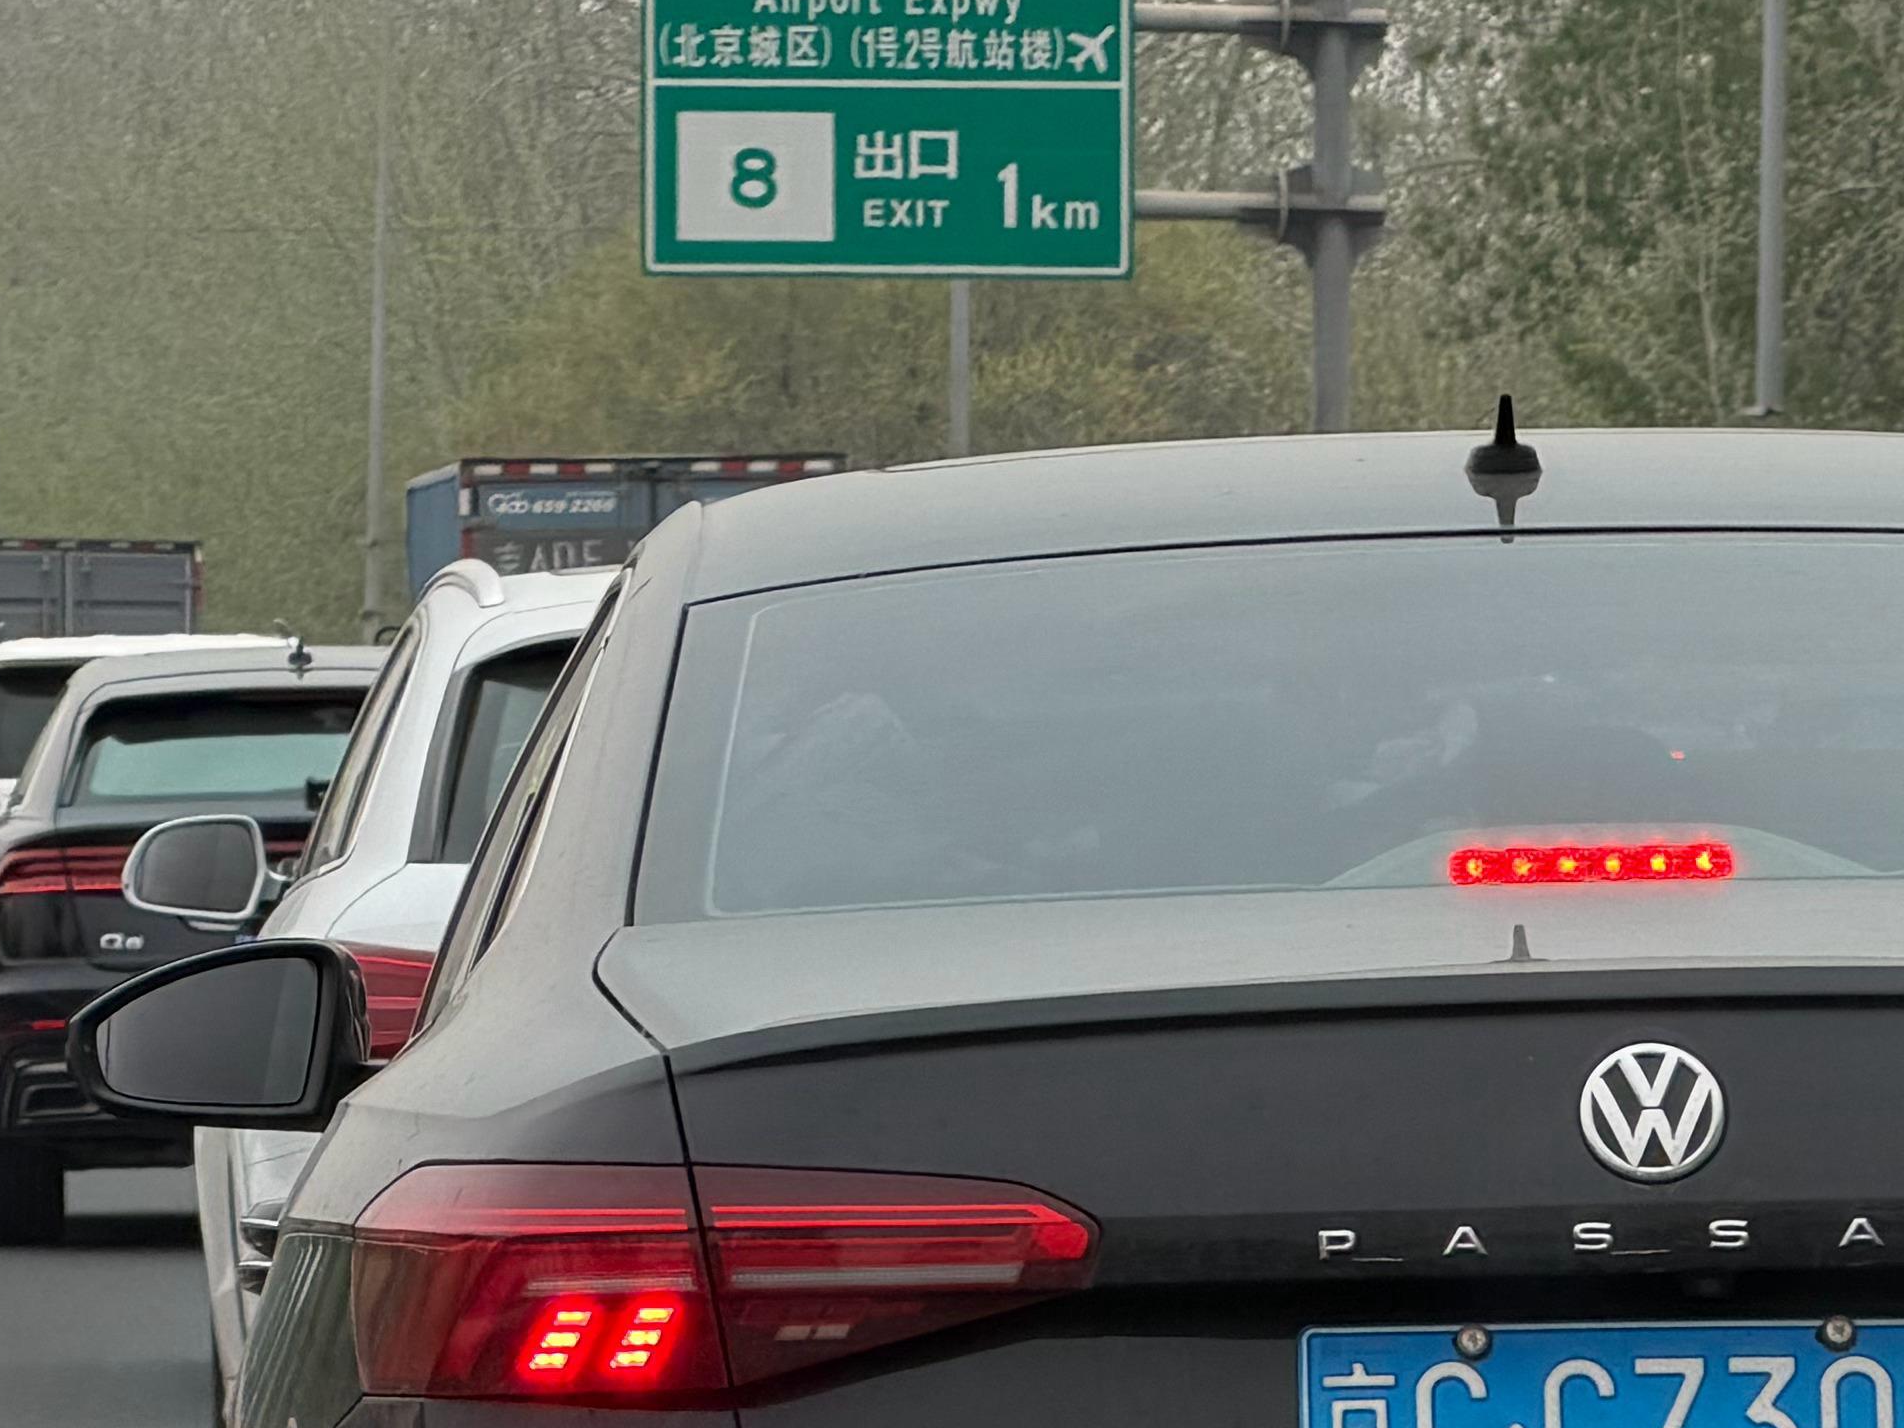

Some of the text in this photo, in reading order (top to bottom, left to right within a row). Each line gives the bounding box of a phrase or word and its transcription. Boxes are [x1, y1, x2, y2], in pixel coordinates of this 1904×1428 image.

[658, 22, 833, 68] (北京城区)
[729, 147, 778, 209] 8
[853, 129, 960, 181] 出口
[862, 199, 950, 228] EXIT
